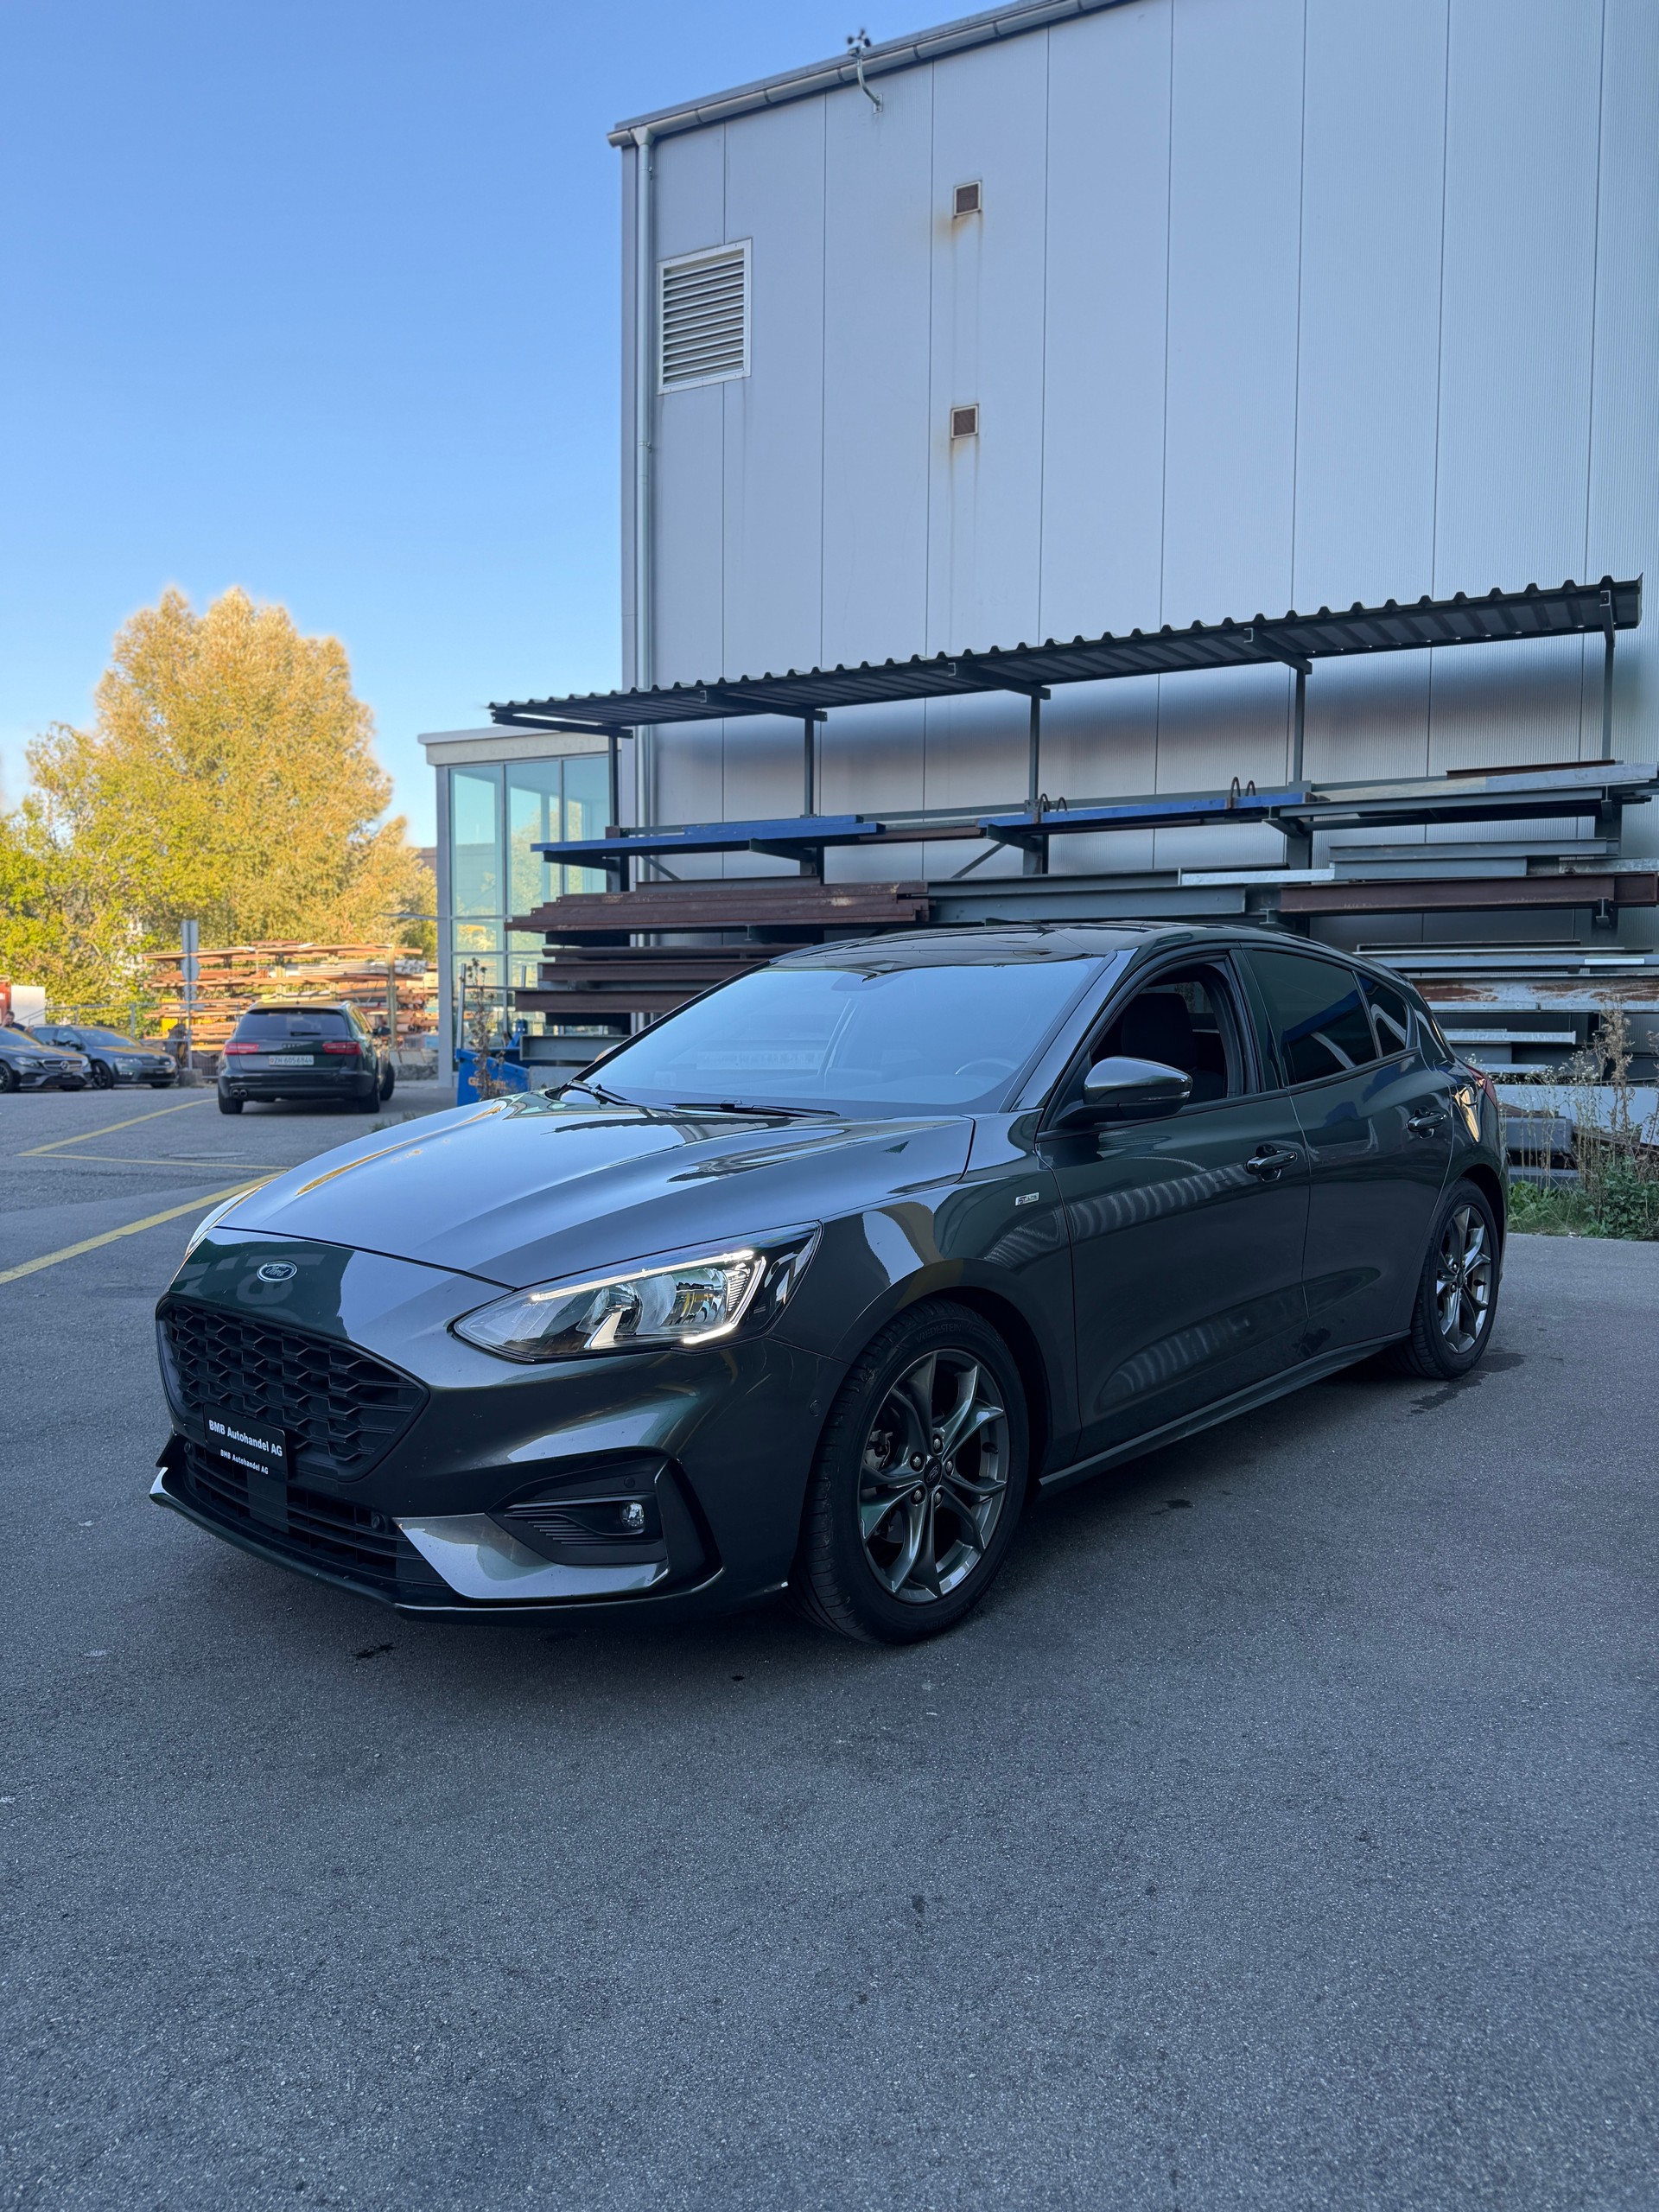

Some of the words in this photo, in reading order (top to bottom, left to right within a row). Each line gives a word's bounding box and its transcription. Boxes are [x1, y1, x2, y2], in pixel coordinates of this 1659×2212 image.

[265, 1265, 289, 1277] Ford
[917, 1323, 962, 1343] VREDESTEIN
[208, 1420, 226, 1435] BMB
[226, 1427, 270, 1452] Autohandel
[270, 1443, 283, 1457] AG
[219, 1449, 232, 1459] BMB
[232, 1454, 260, 1471] Autohandel
[261, 1465, 269, 1475] AG
